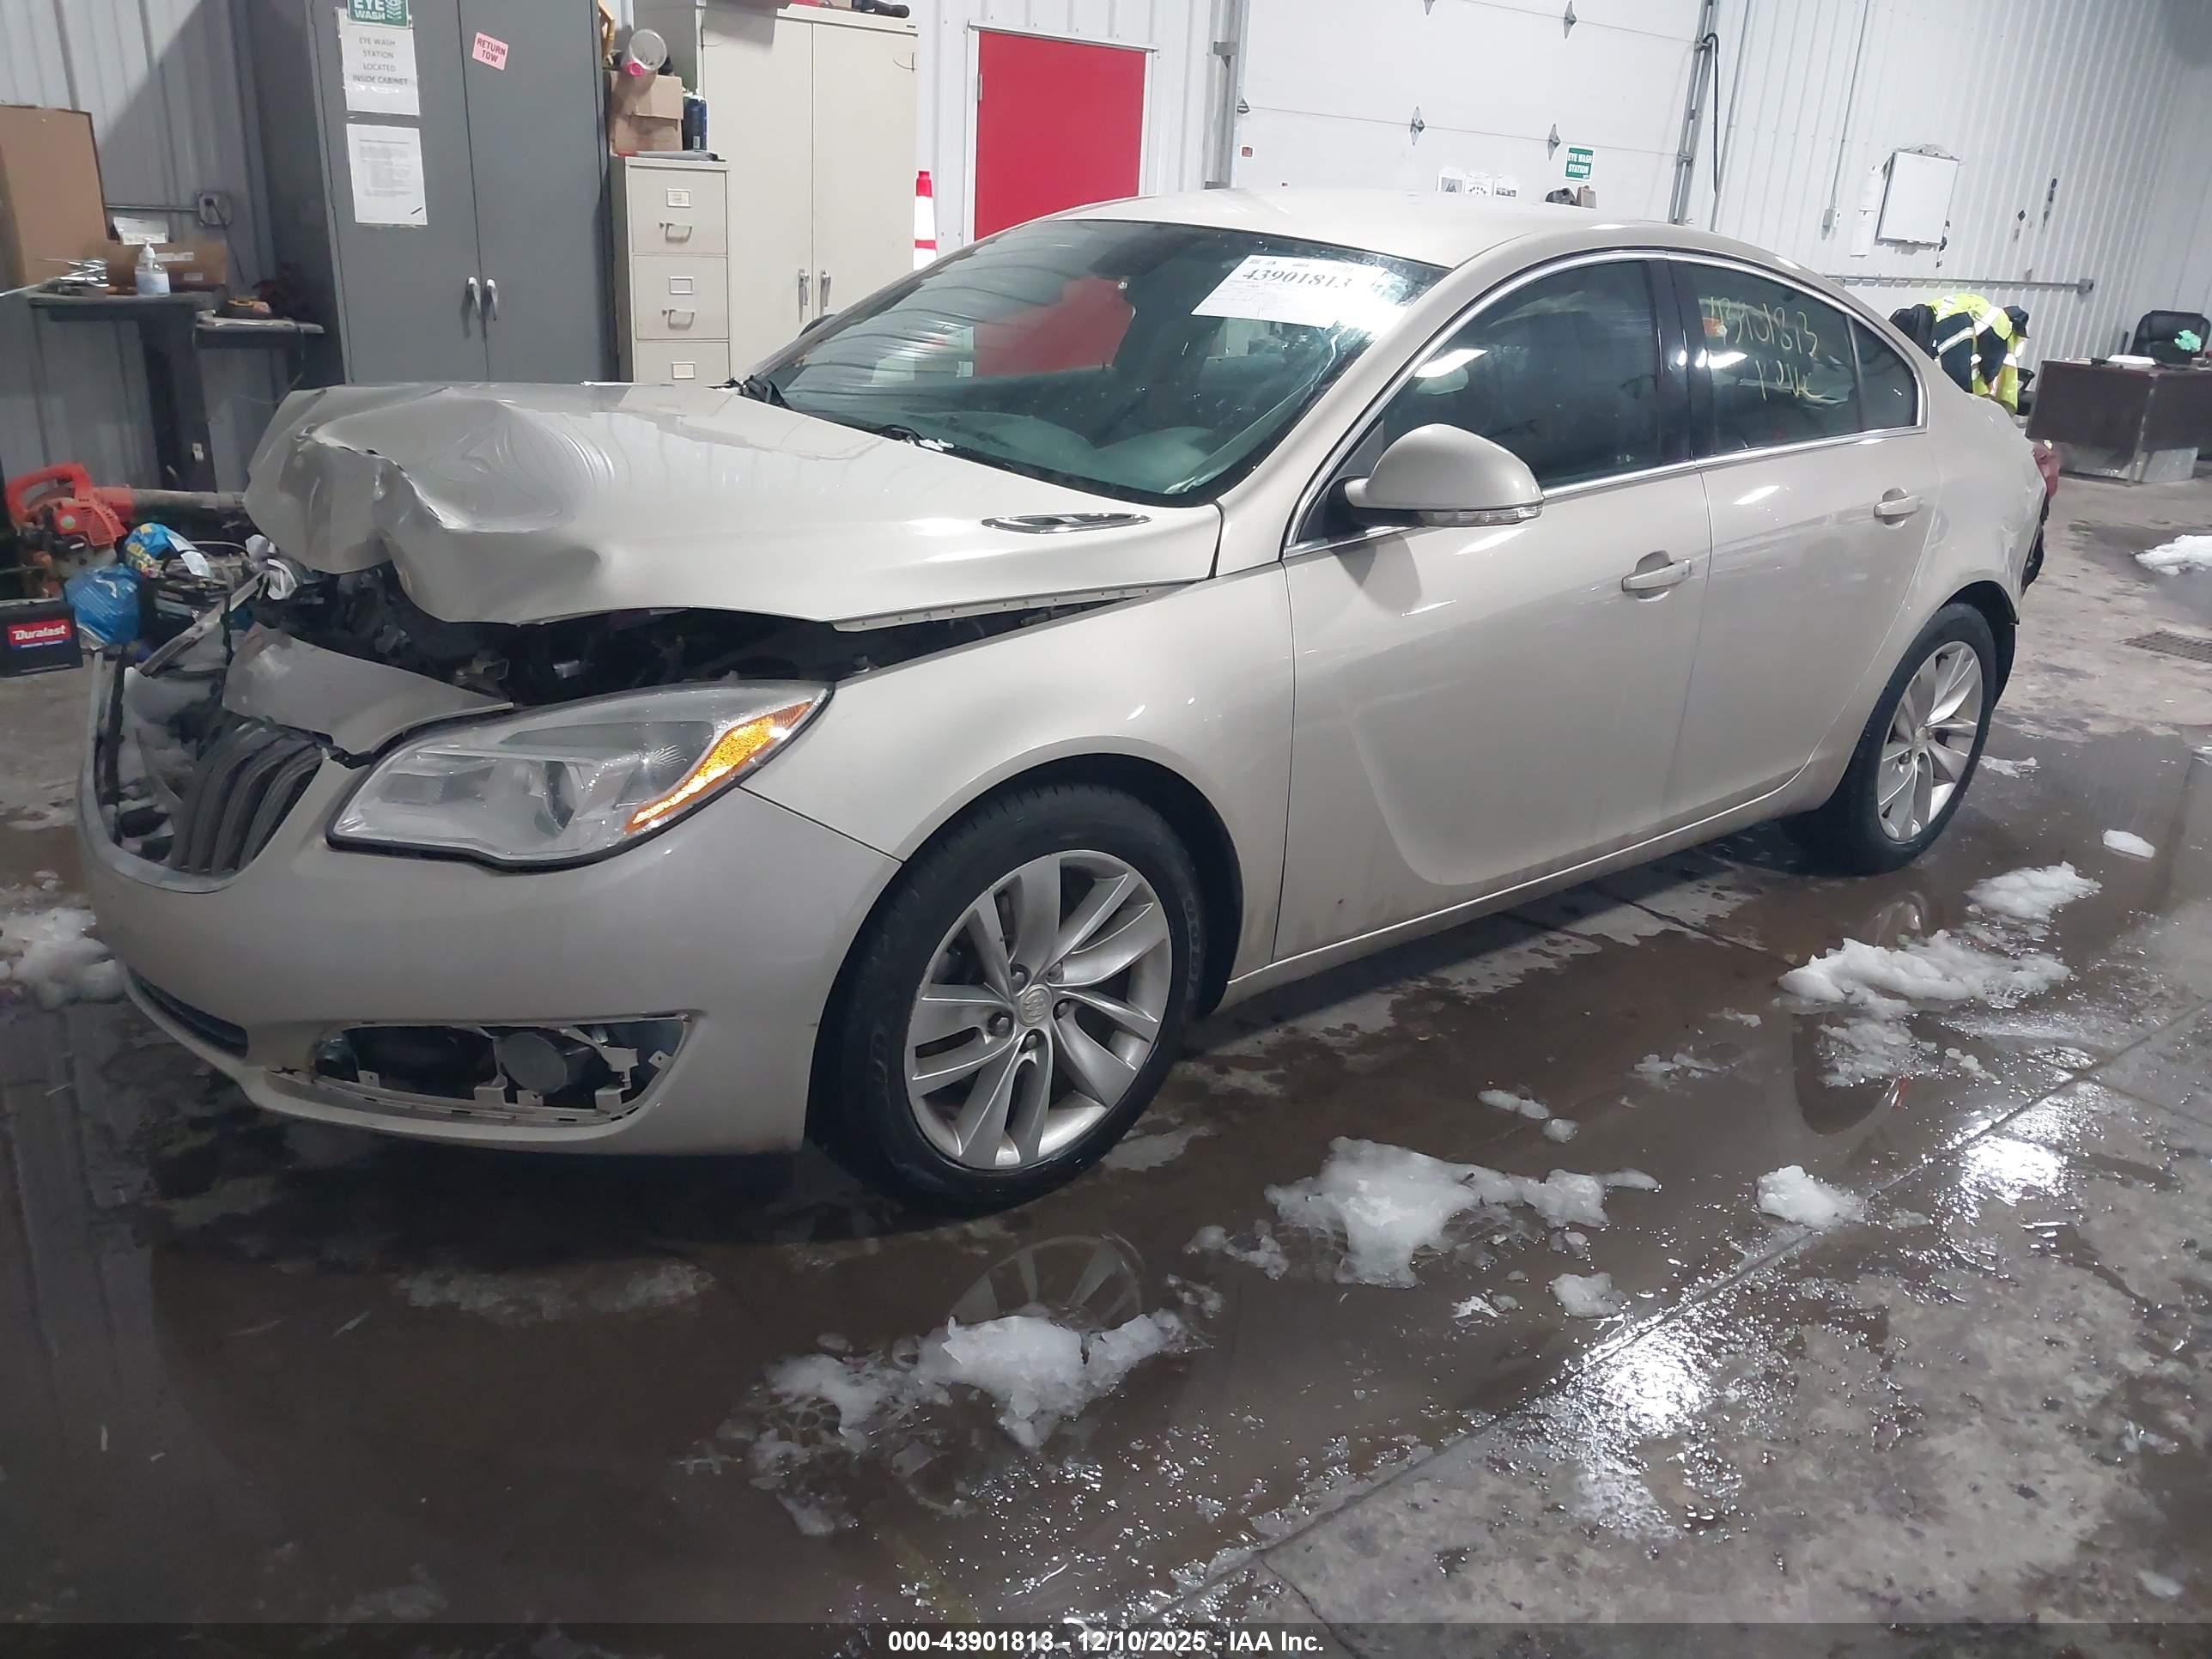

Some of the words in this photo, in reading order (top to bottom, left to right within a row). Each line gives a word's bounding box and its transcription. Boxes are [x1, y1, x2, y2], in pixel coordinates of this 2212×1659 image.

[354, 9, 386, 21] WASH
[358, 36, 371, 45] EYE
[374, 38, 395, 46] WASH
[477, 37, 506, 57] RETURN
[362, 50, 394, 58] STATION
[482, 50, 498, 62] TOW
[362, 63, 397, 72] LOCATED
[352, 75, 375, 83] INSIDE
[378, 76, 408, 85] CABINET
[12, 624, 66, 641] Duralast
